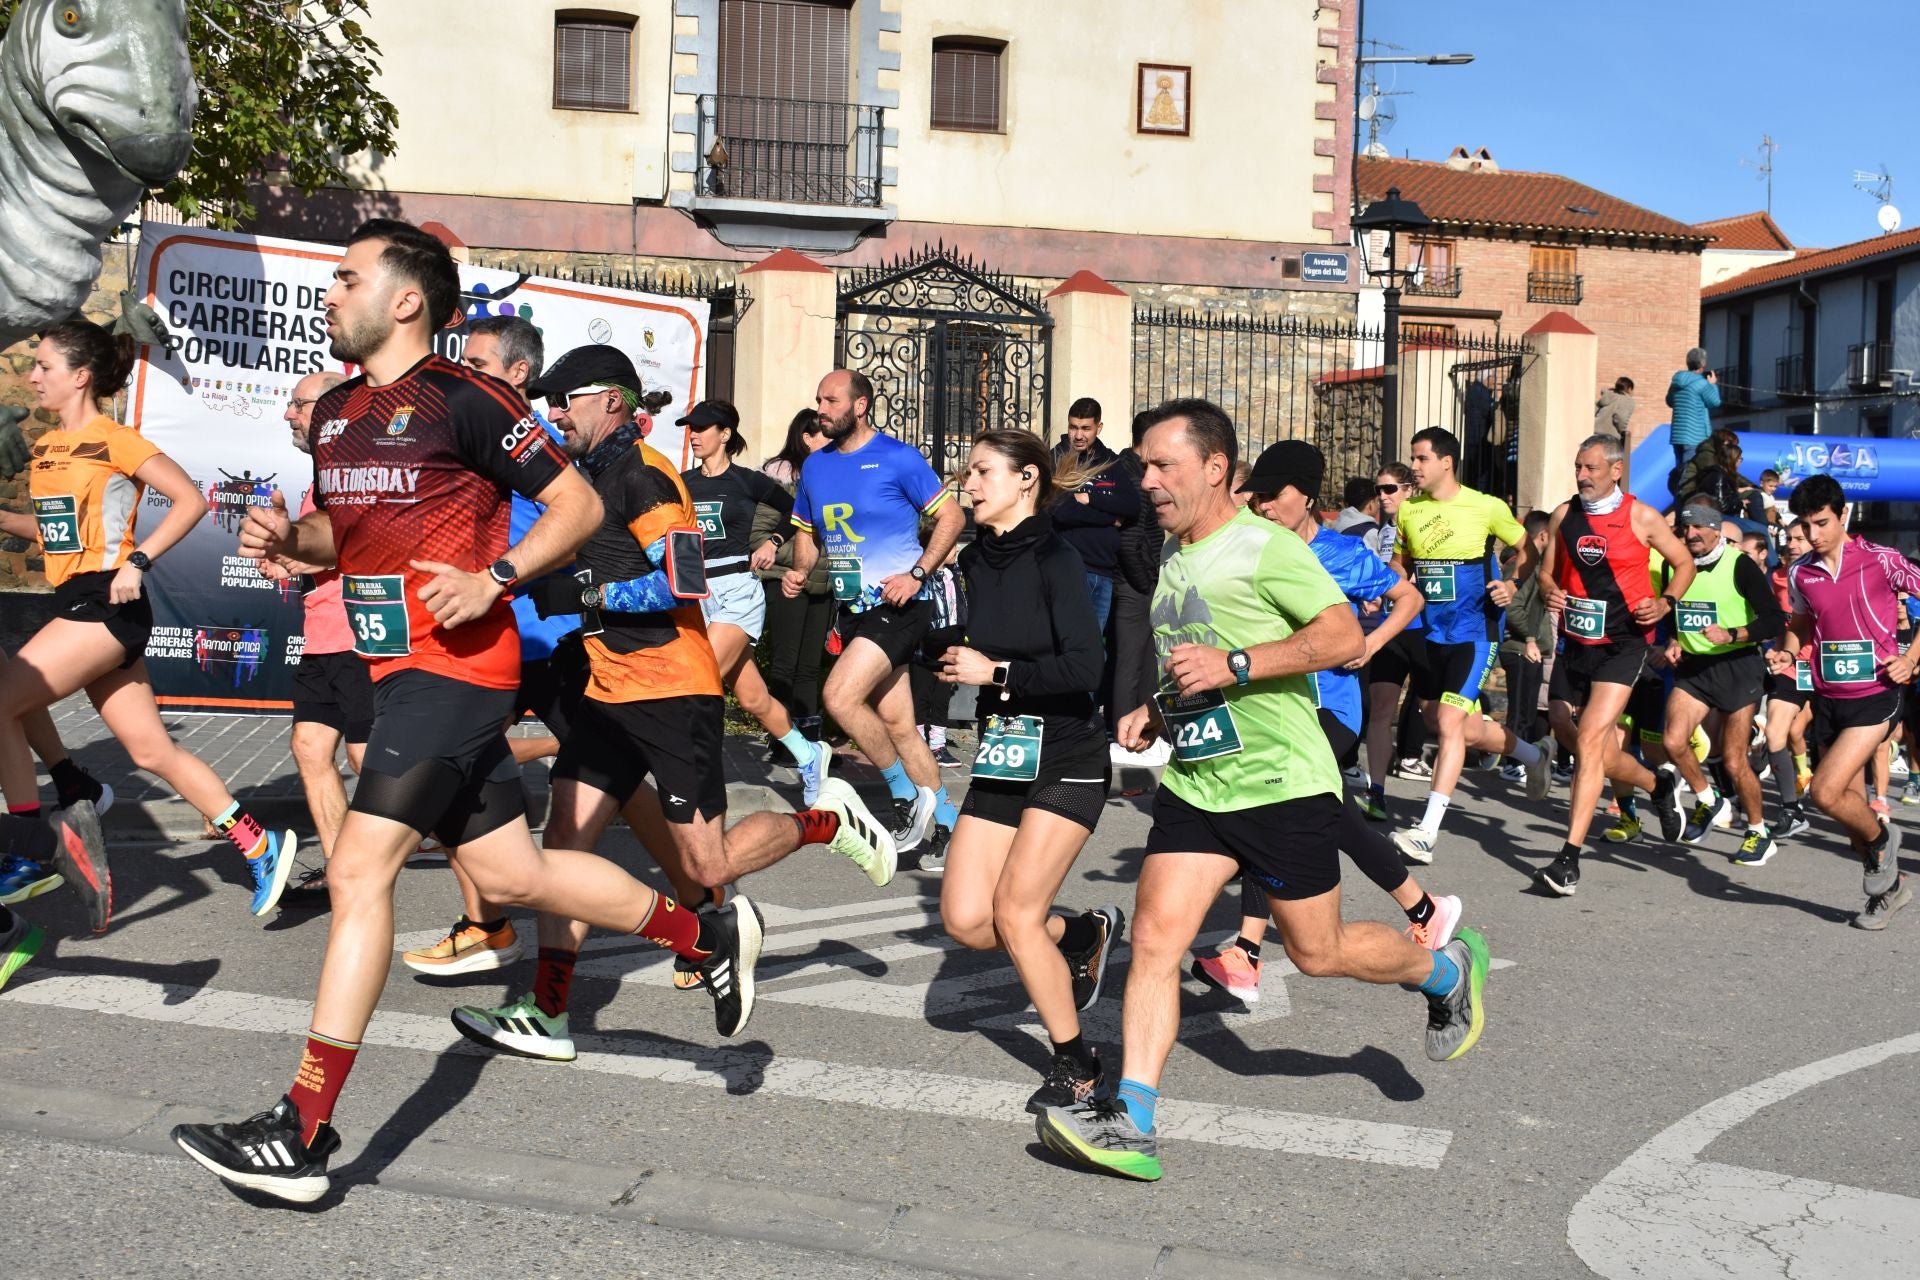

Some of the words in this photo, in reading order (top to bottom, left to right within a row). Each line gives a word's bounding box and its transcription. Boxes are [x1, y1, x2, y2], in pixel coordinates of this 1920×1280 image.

[1313, 258, 1338, 267] Avenida
[1304, 267, 1321, 277] Virgen
[1332, 268, 1347, 276] Villar
[169, 269, 288, 307] CIRCUITO
[296, 285, 327, 312] DE
[169, 300, 327, 345] CARRERAS
[165, 334, 325, 375] POPULARES
[202, 391, 211, 400] La
[212, 393, 228, 402] Rioja
[251, 396, 276, 406] Navarra
[320, 418, 349, 437] OCR
[502, 417, 536, 451] OCR
[1795, 445, 1876, 470] IGEA
[1841, 482, 1871, 491] ENTOS
[212, 492, 244, 505] RAMON
[328, 497, 346, 505] OCR
[347, 496, 377, 505] RACE
[823, 503, 865, 543] R
[1418, 513, 1442, 533] RINCON
[40, 521, 70, 542] 262
[826, 534, 842, 543] CLUB
[827, 543, 857, 554] MARATÓN
[1426, 530, 1454, 555] ATLETISMO
[222, 556, 257, 567] CIRCUIT
[221, 577, 275, 590] POPULARES
[834, 576, 845, 592] 9
[1425, 581, 1442, 595] 44
[355, 612, 387, 641] 35
[1569, 613, 1596, 631] 220
[1683, 614, 1712, 627] 200
[183, 628, 193, 638] DE
[147, 636, 194, 648] ARRERAS
[201, 638, 232, 652] RAMON
[233, 640, 260, 653] OPTICA
[145, 647, 192, 658] OPULARES
[1834, 660, 1860, 675] 65
[1172, 717, 1223, 748] 224
[975, 742, 1025, 768] 269
